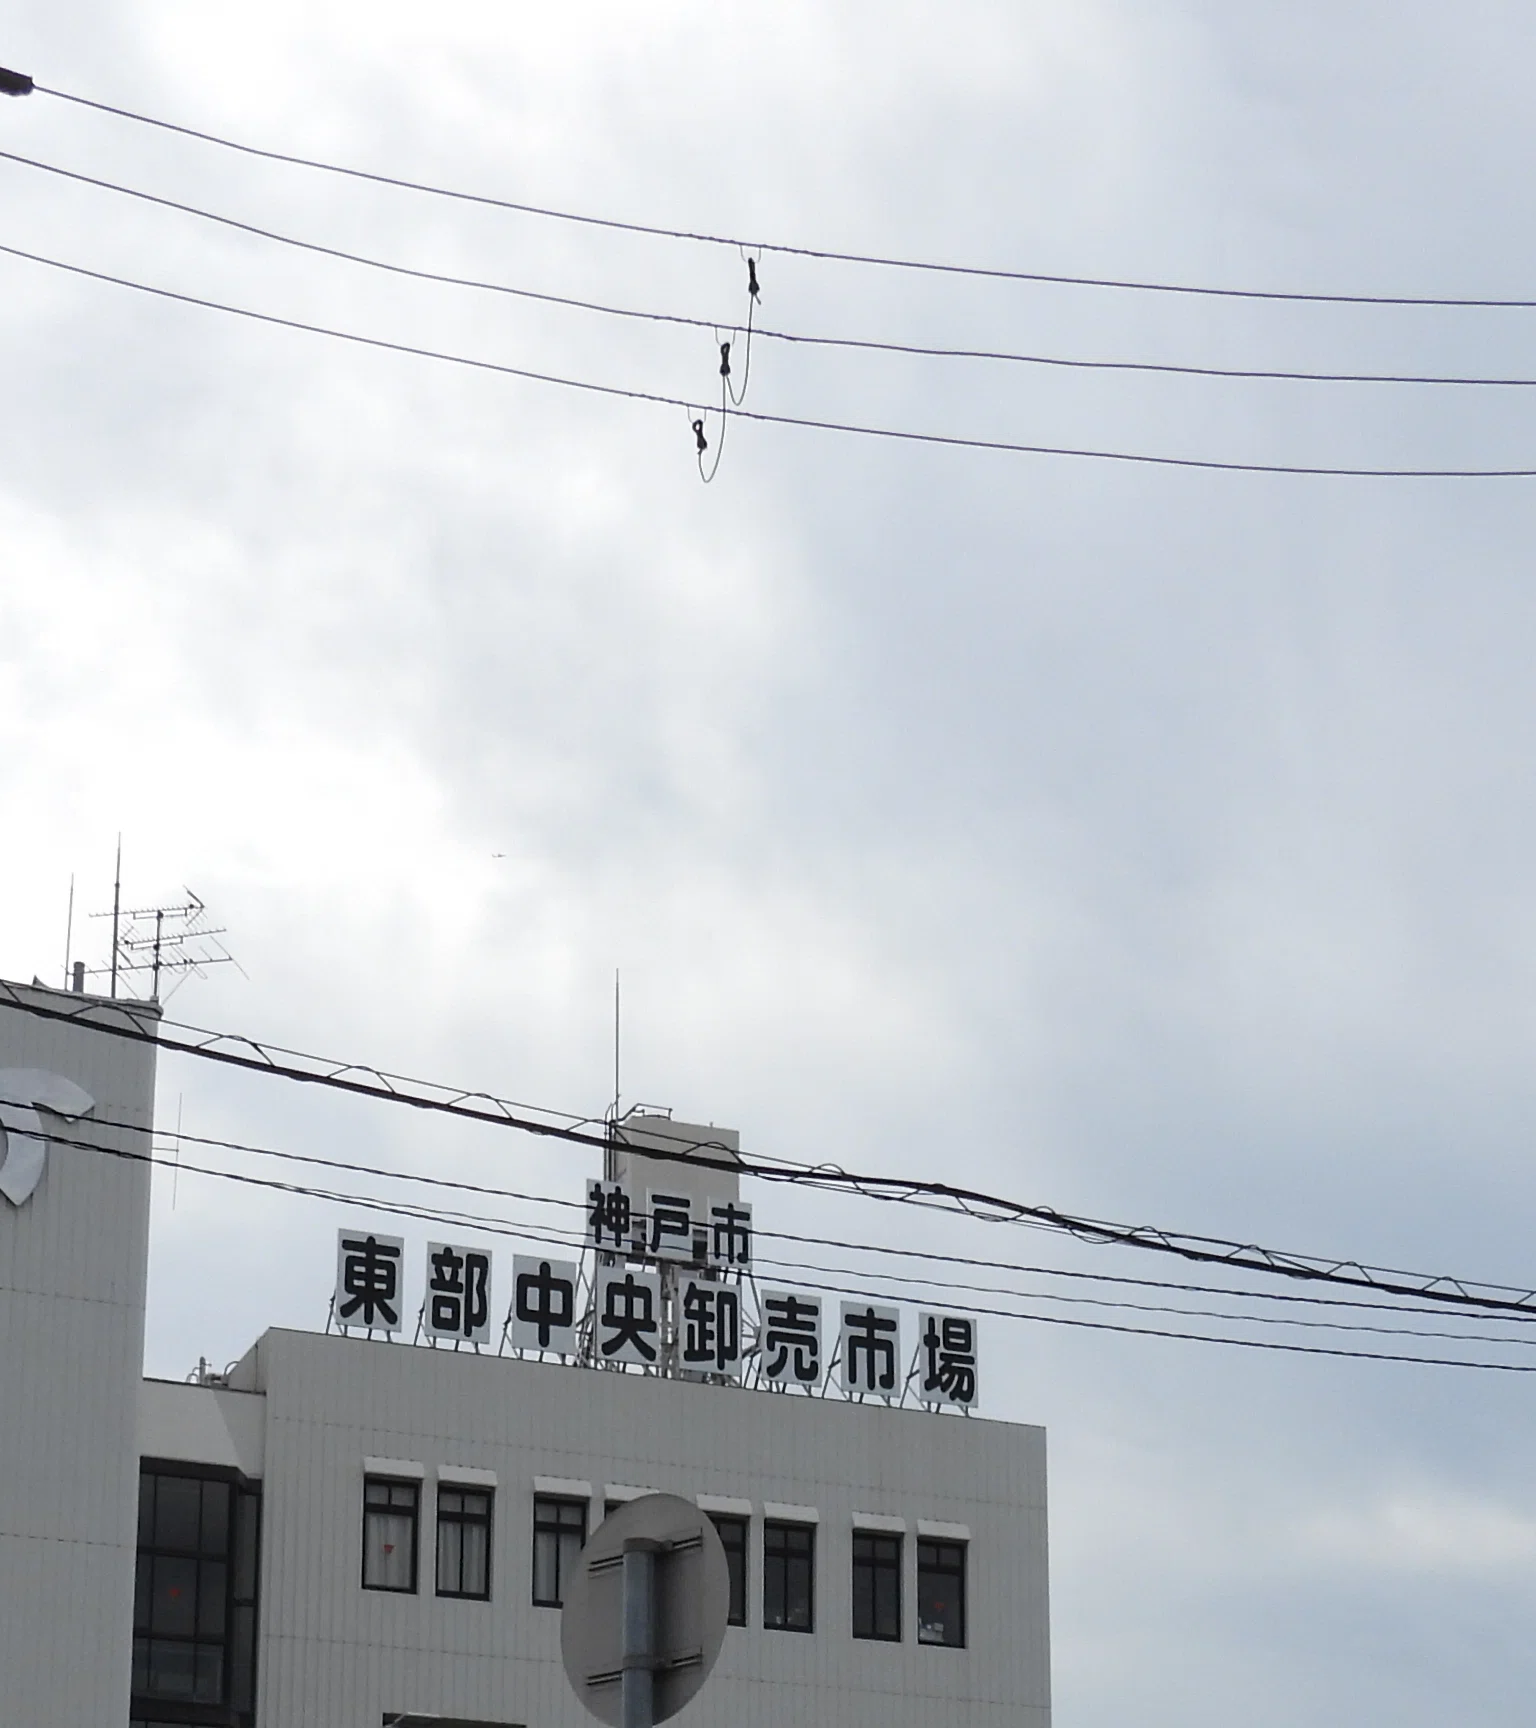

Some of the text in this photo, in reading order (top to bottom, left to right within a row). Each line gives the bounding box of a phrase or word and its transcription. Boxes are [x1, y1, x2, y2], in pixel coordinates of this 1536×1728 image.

[588, 1183, 751, 1265] 神戸市
[339, 1235, 976, 1405] 東部中央卸売市場
